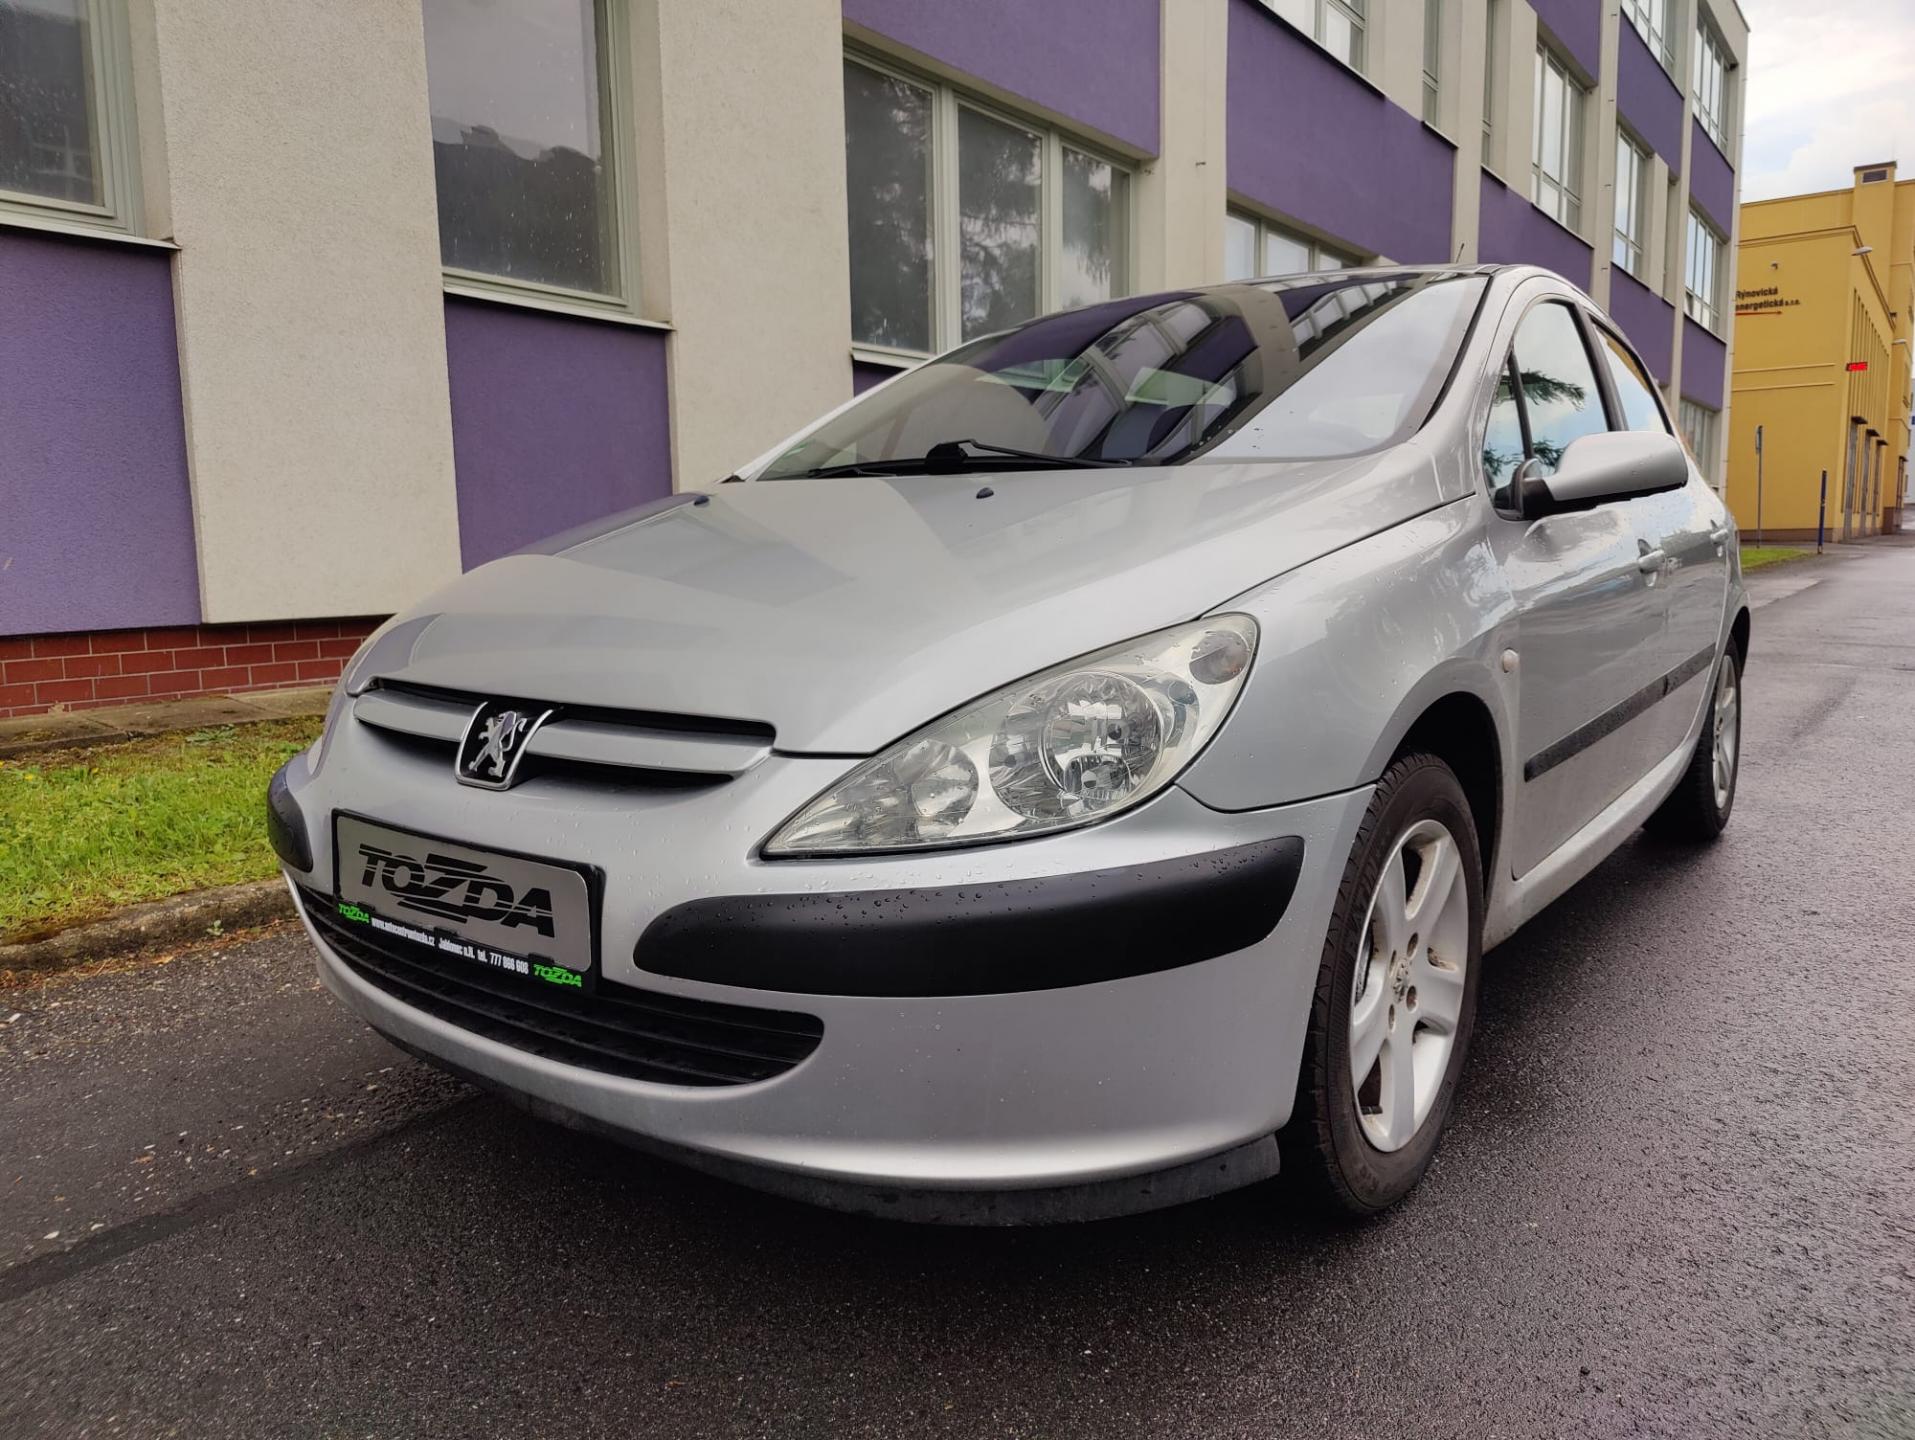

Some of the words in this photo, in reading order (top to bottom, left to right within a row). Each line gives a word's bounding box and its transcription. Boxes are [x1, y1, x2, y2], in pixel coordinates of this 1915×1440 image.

[358, 843, 555, 938] TOZDA
[339, 903, 370, 924] TOZDA
[490, 952, 502, 967] 777
[533, 964, 582, 988] TOZDA
